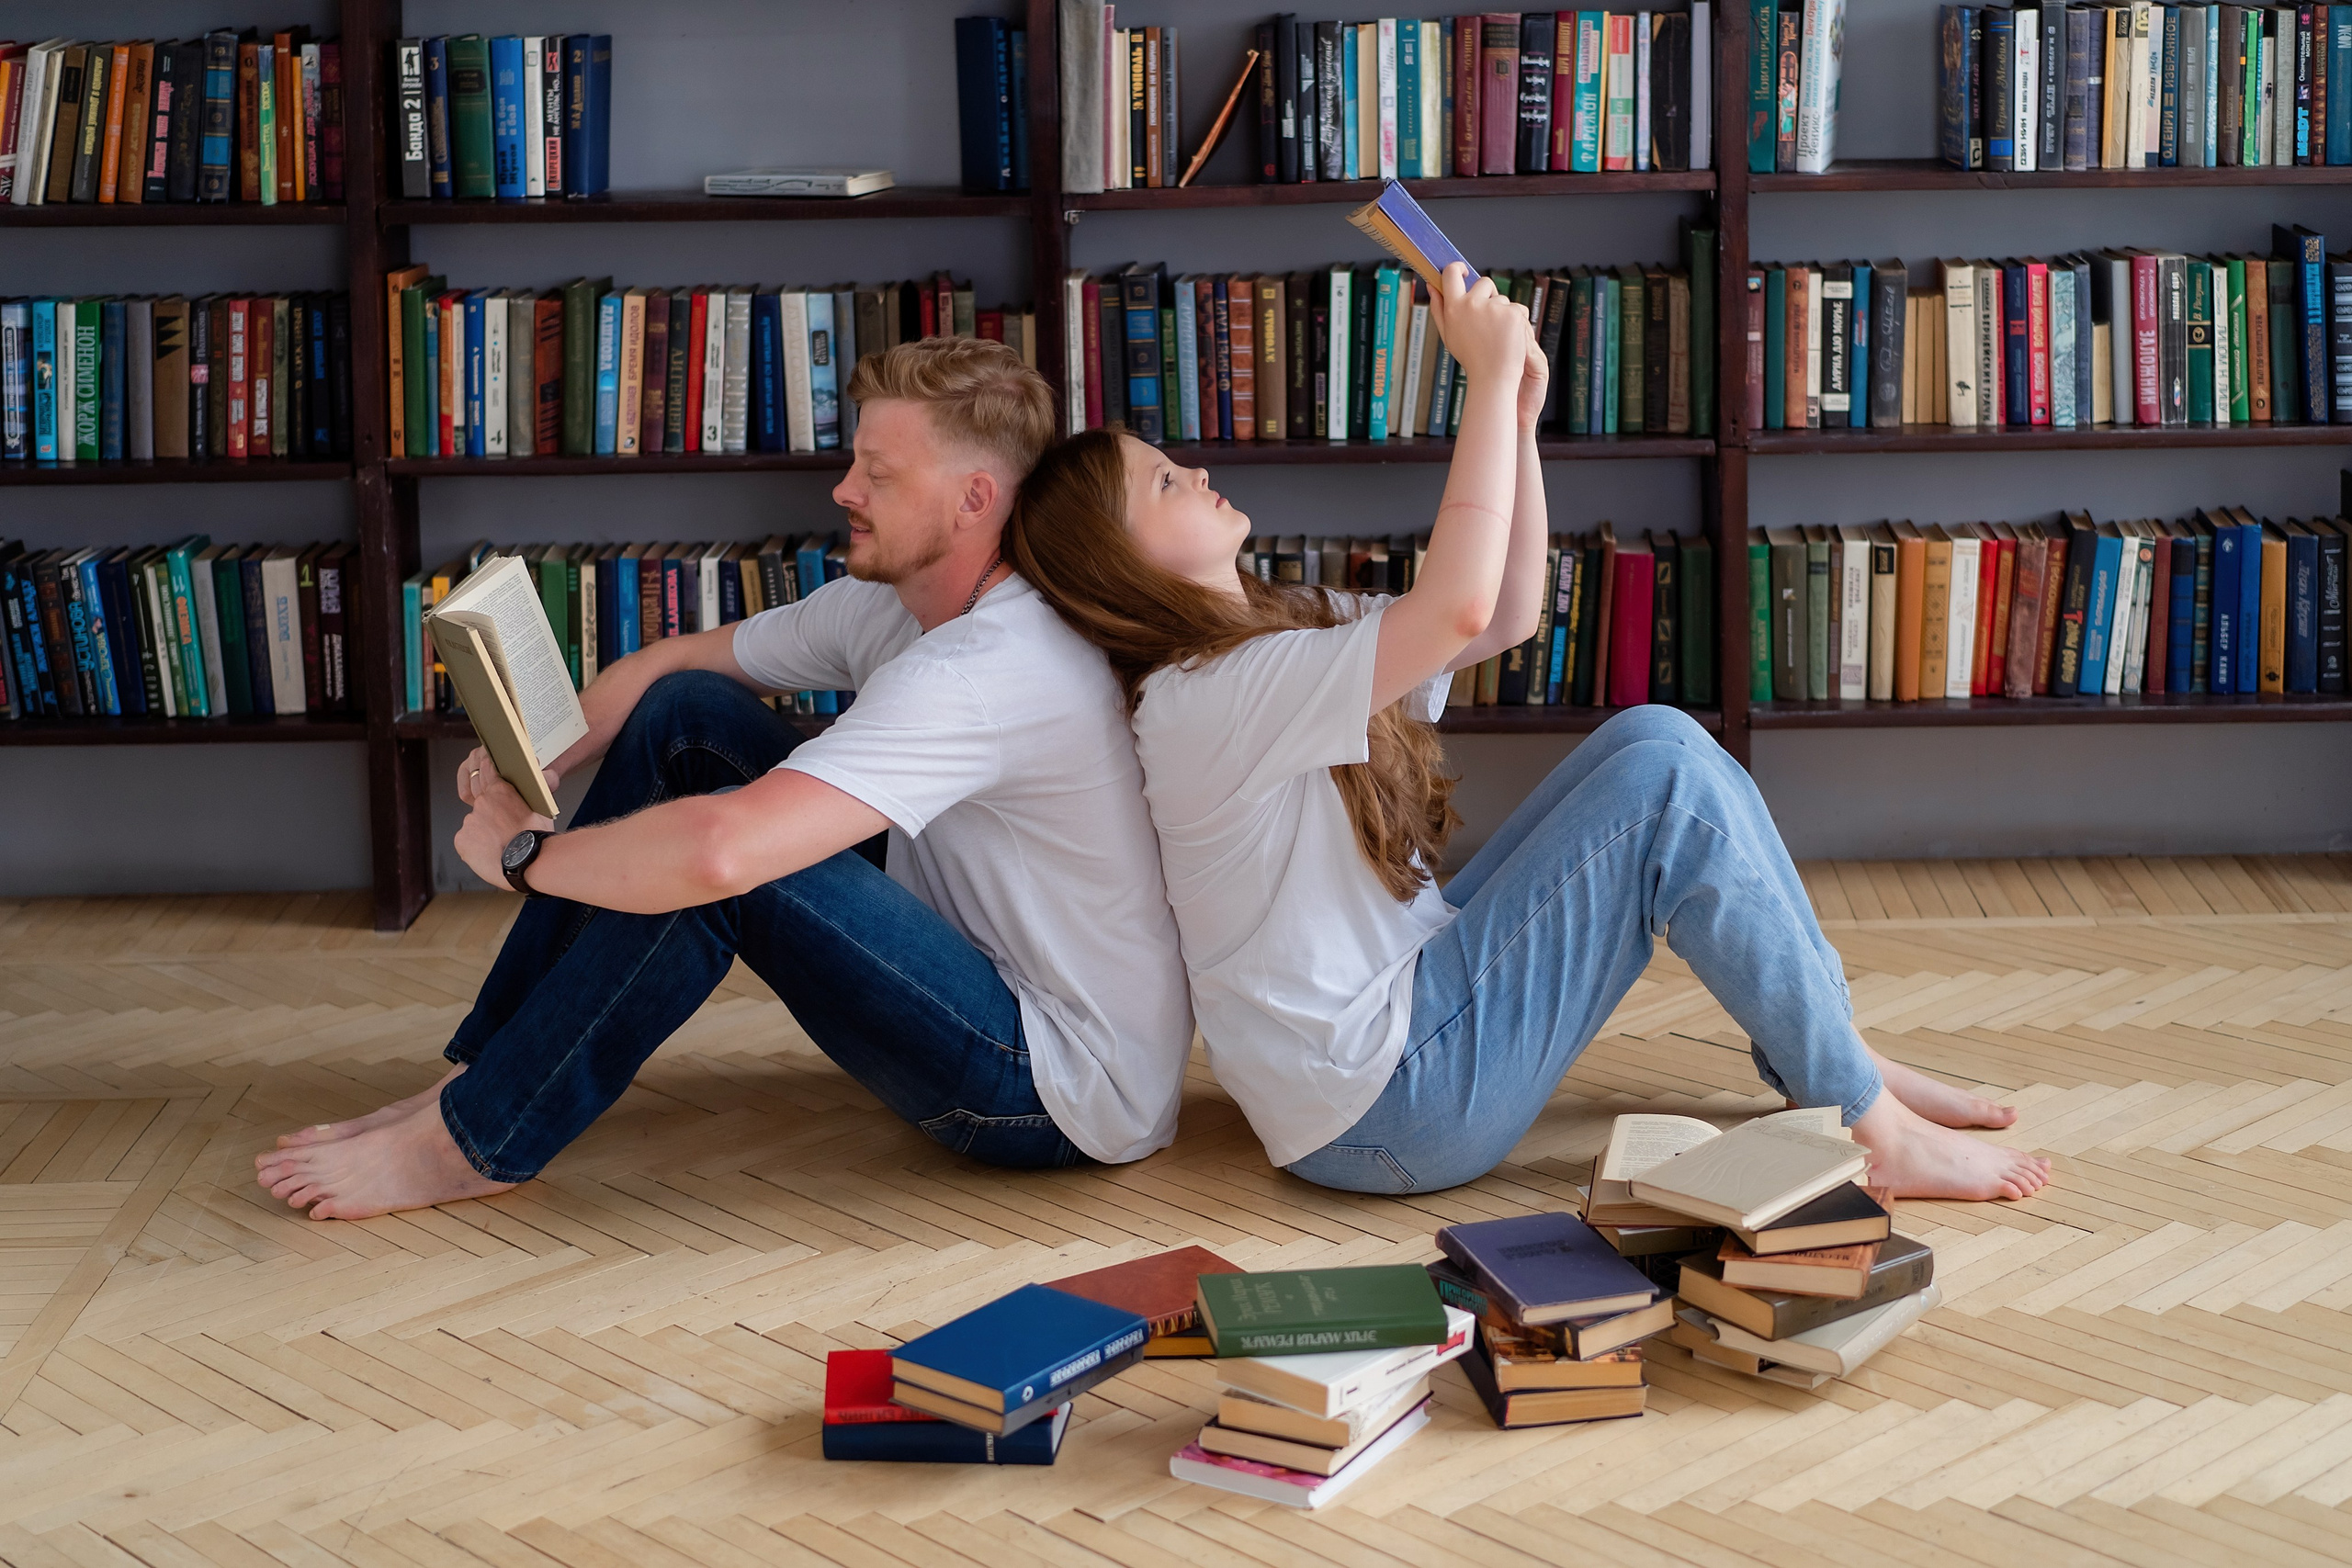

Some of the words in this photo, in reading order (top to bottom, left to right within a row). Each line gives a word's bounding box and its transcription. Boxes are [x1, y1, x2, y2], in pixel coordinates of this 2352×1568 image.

[1804, 0, 1817, 37] DevOps
[1320, 37, 1335, 81] детектив
[2165, 17, 2176, 88] ИЗБРАННОЕ
[403, 98, 422, 110] 2
[1320, 85, 1339, 152] Американский
[404, 112, 424, 162] Банда
[1580, 93, 1597, 163] ФАРДЖОН
[1798, 113, 1809, 158] Проект
[2163, 111, 2174, 159] О.ГЕНРИ
[498, 150, 509, 186] Юрий
[2031, 274, 2043, 306] БИЛЕТ
[629, 306, 641, 345] ИДОЛОВ
[1215, 297, 1227, 333] ГАРТ
[2031, 308, 2043, 348] ВОЛЧИЙ
[1295, 320, 1303, 356] ЗИЛАЗНИ
[1982, 312, 1991, 383] ВЕРНЕЙСКИЕ
[2217, 324, 2227, 365] ЛИЦОМ
[76, 325, 96, 399] СИМЕНОН
[628, 348, 638, 381] БРЕМЯ
[1373, 348, 1387, 398] ФИЗИКА
[2033, 352, 2045, 392] ЛЕОНОВ
[1982, 387, 1991, 421] ГРАЧИ
[2217, 382, 2229, 412] ЛИЦУ
[76, 400, 96, 446] ЖОРЖ
[667, 569, 678, 624] ДАШКОВА
[1556, 592, 1568, 614] ОЛЕГ
[69, 602, 95, 671] УСТИНОВА
[1240, 1333, 1295, 1349] РЕМАРК
[1296, 1331, 1340, 1347] МАРИЯ
[1340, 1329, 1377, 1344] ЭРИХ
